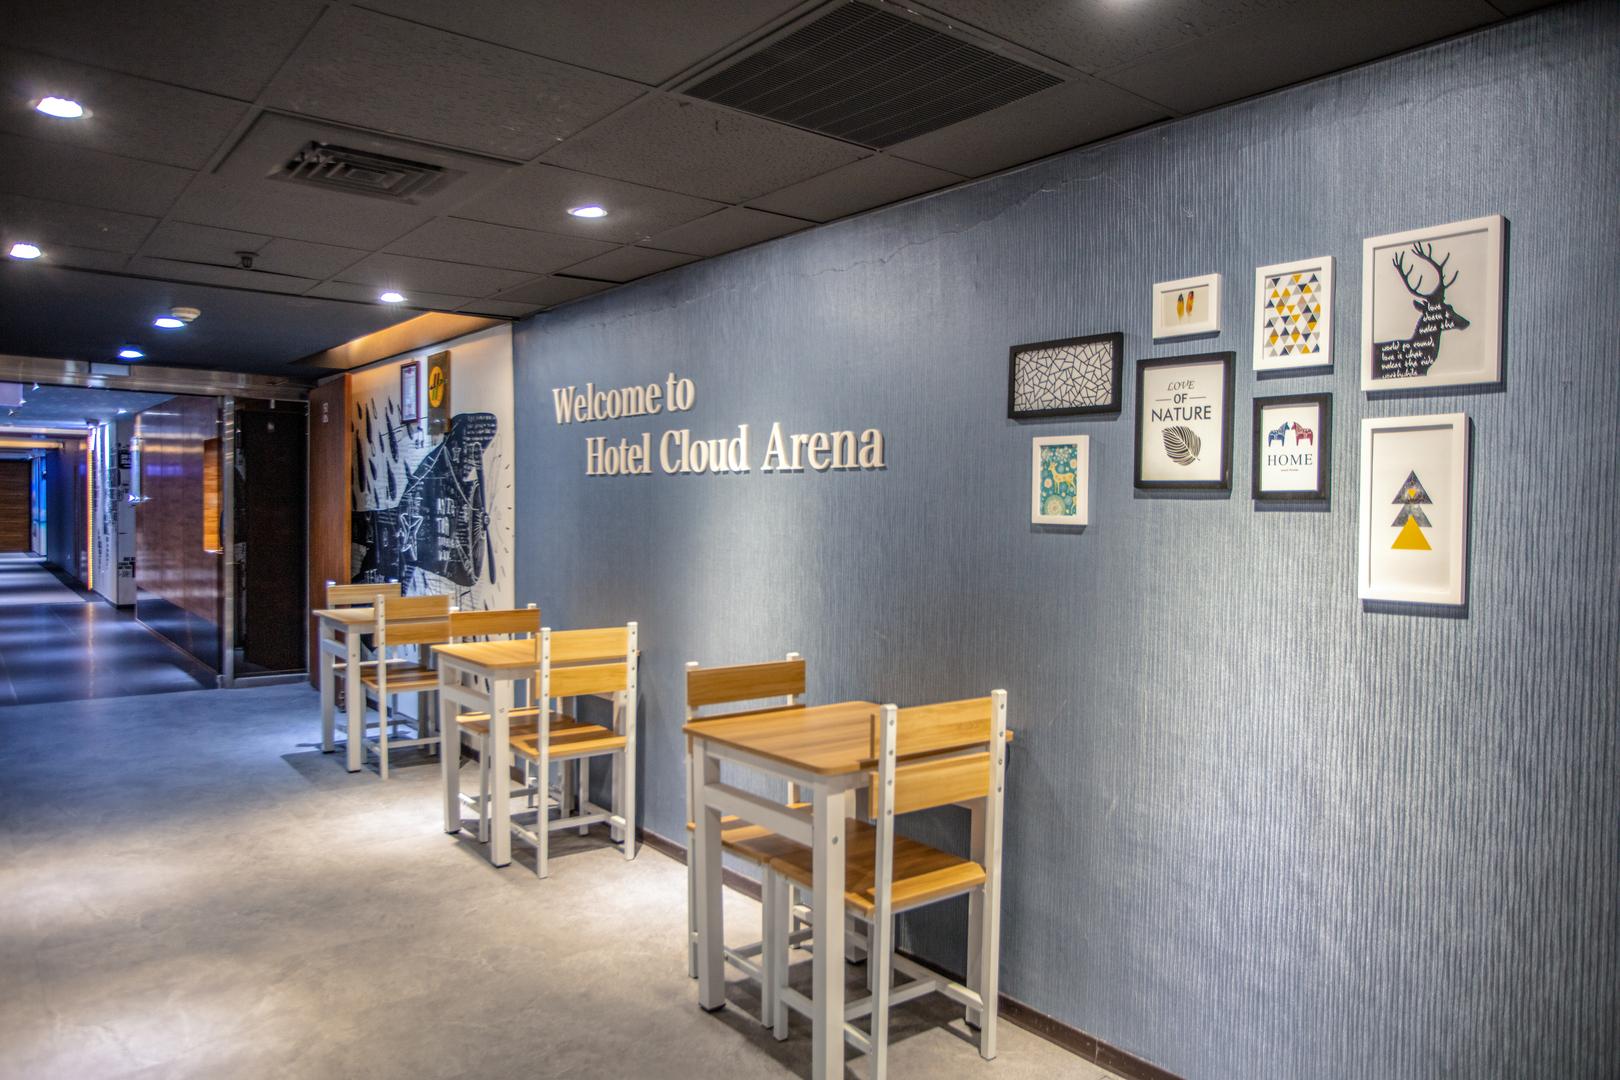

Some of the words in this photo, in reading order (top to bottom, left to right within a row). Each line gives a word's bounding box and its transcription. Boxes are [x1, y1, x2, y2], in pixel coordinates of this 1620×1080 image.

[1381, 341, 1400, 351] world
[1167, 380, 1196, 391] LOVE
[552, 382, 662, 424] Welcome
[666, 372, 695, 412] to
[1173, 393, 1188, 404] OF
[1151, 405, 1212, 422] NATURE
[585, 432, 652, 476] Hotel
[659, 424, 750, 474] Cloud
[760, 422, 886, 471] Arena
[1267, 454, 1313, 467] HOME
